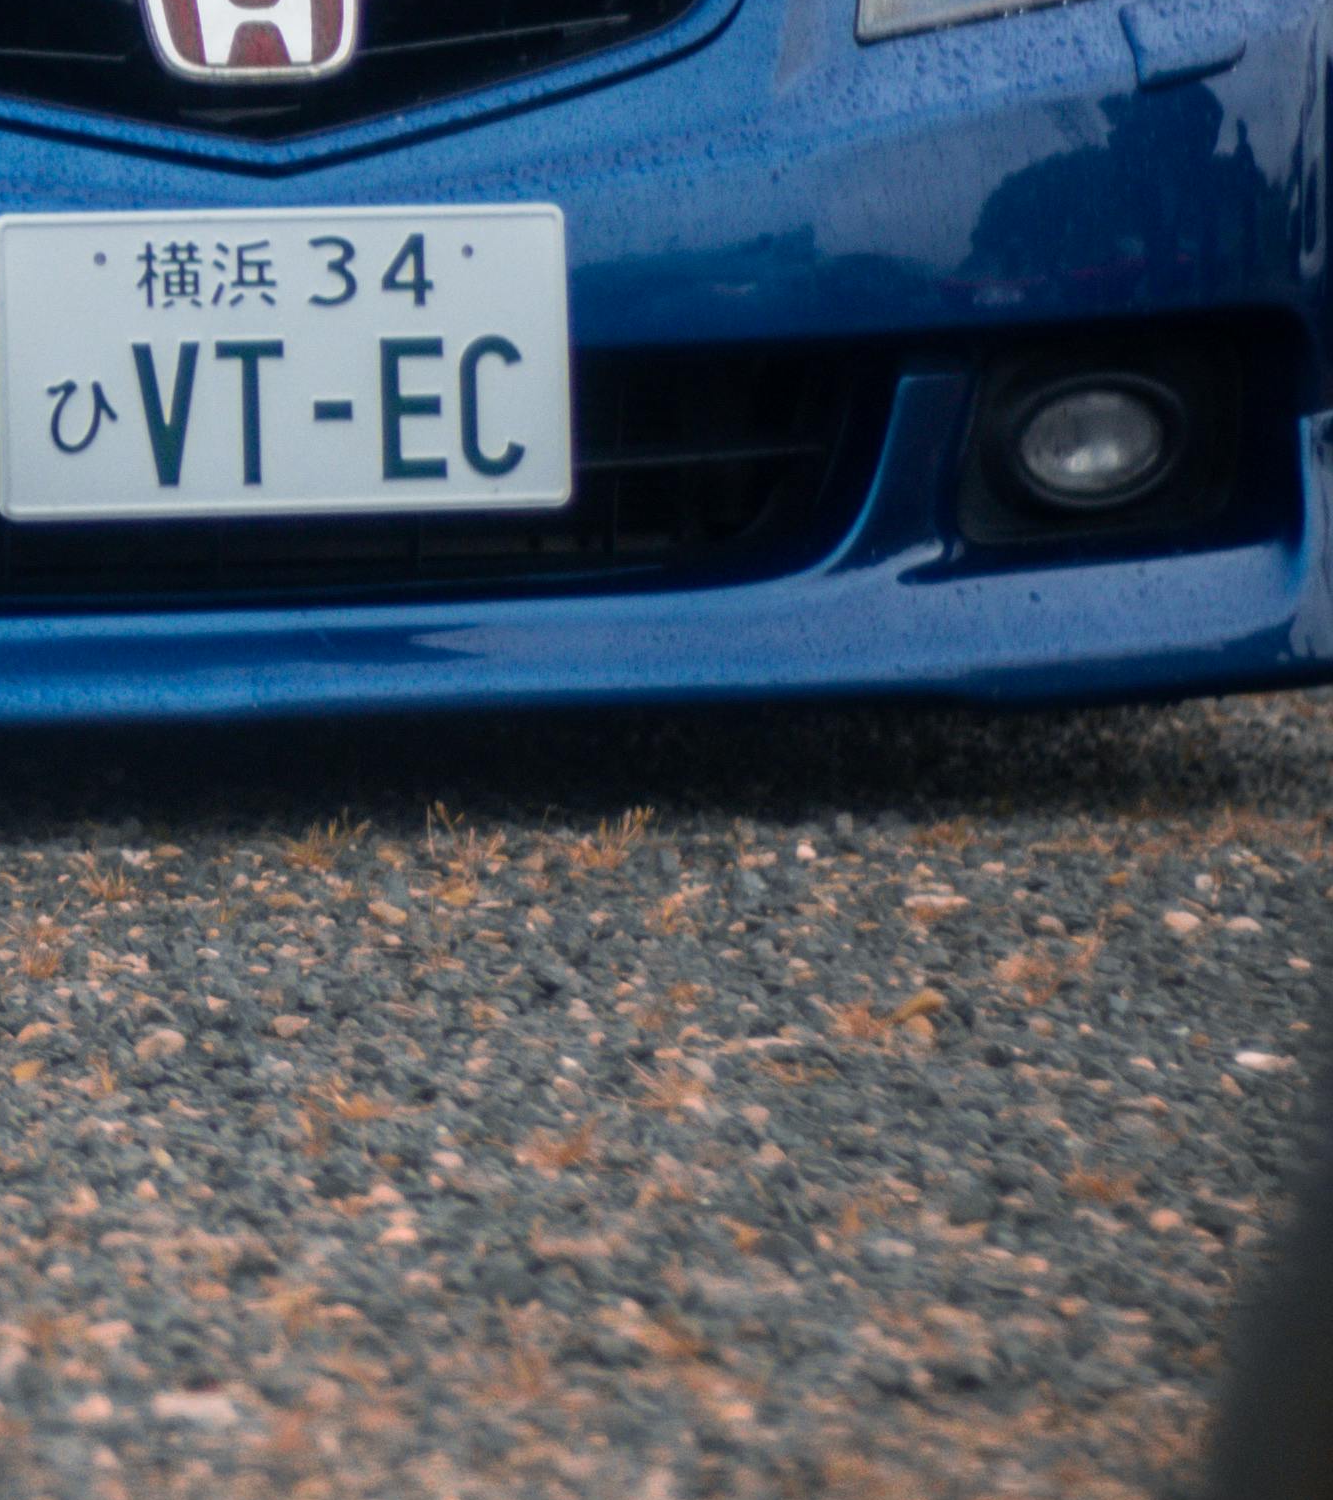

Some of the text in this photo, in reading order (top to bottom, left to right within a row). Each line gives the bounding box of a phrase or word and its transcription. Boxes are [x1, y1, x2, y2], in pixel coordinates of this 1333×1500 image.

[135, 232, 435, 309] 横浜 34
[45, 333, 527, 488] ひ VT-EC
